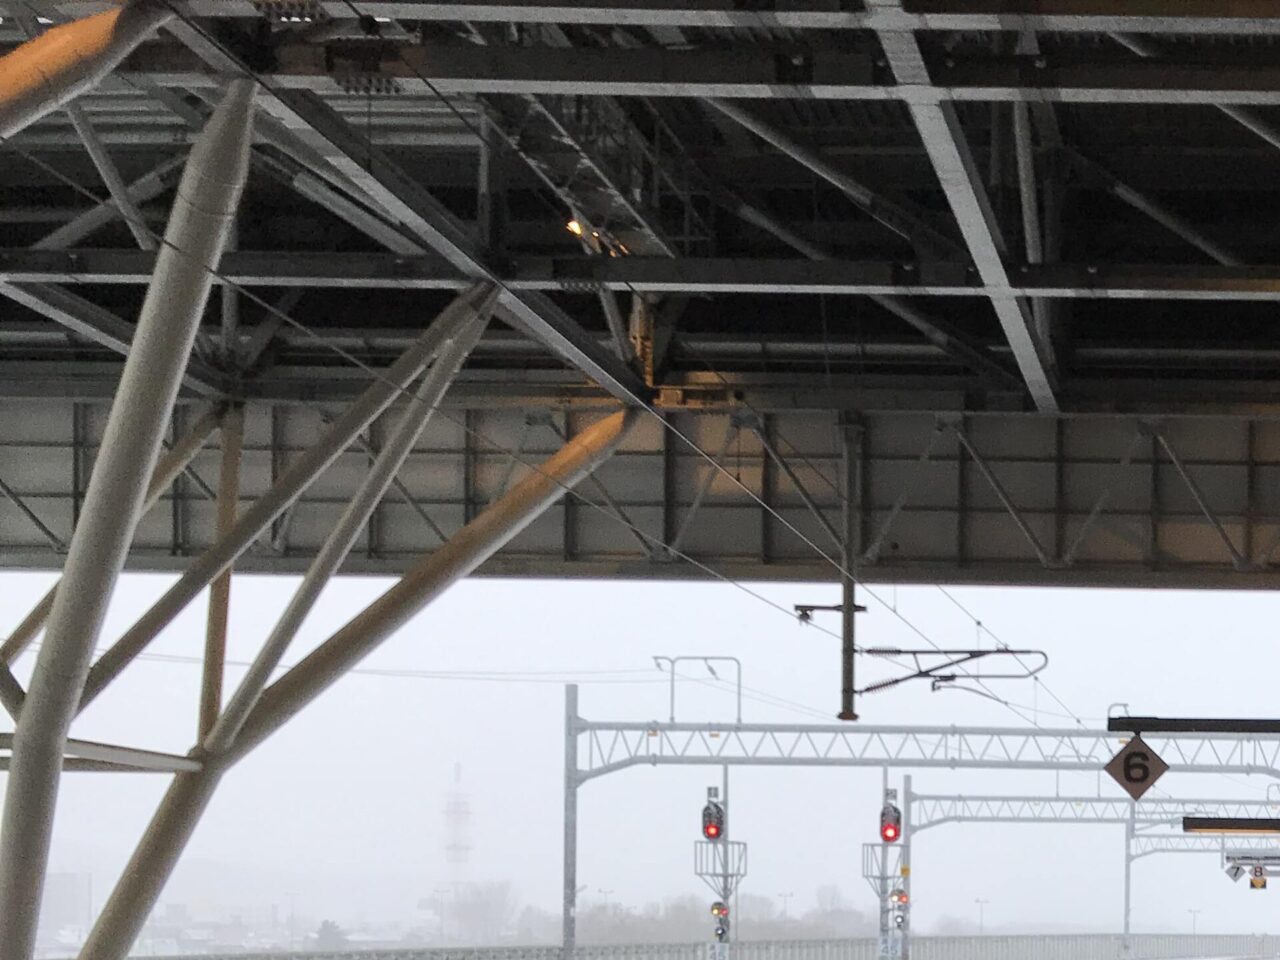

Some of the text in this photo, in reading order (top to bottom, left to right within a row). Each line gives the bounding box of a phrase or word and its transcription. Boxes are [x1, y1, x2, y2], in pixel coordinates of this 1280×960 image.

[1123, 751, 1150, 784] 6
[1231, 866, 1240, 877] 7
[1254, 866, 1263, 877] 8
